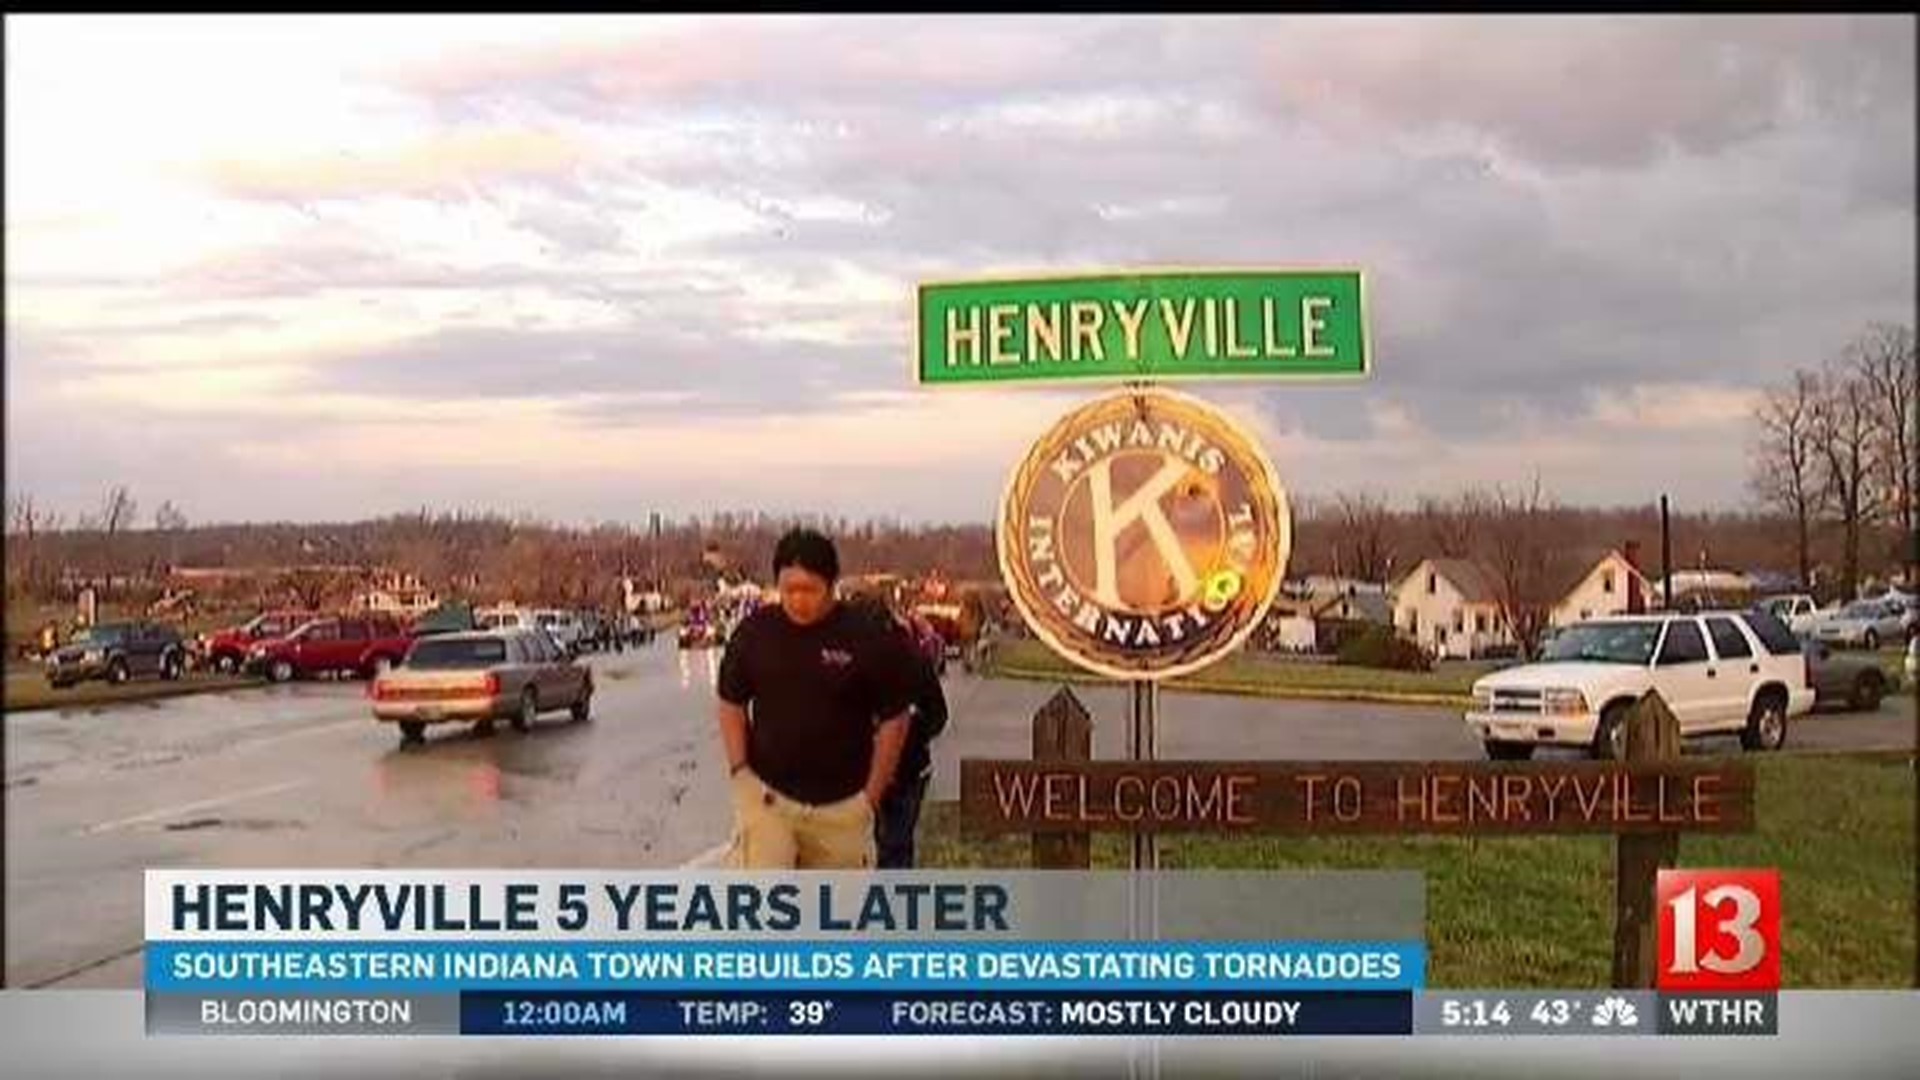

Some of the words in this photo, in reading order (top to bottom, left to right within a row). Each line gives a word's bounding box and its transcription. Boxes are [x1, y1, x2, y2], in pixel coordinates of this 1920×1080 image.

[945, 296, 1336, 367] HENRYVILLE
[1050, 420, 1226, 484] KIWANIS
[1088, 455, 1200, 608] K
[1028, 502, 1258, 645] INTERNATIOAL
[994, 773, 1257, 823] WELCOME
[1298, 774, 1363, 822] TO
[1397, 772, 1722, 823] HENRYVILLE
